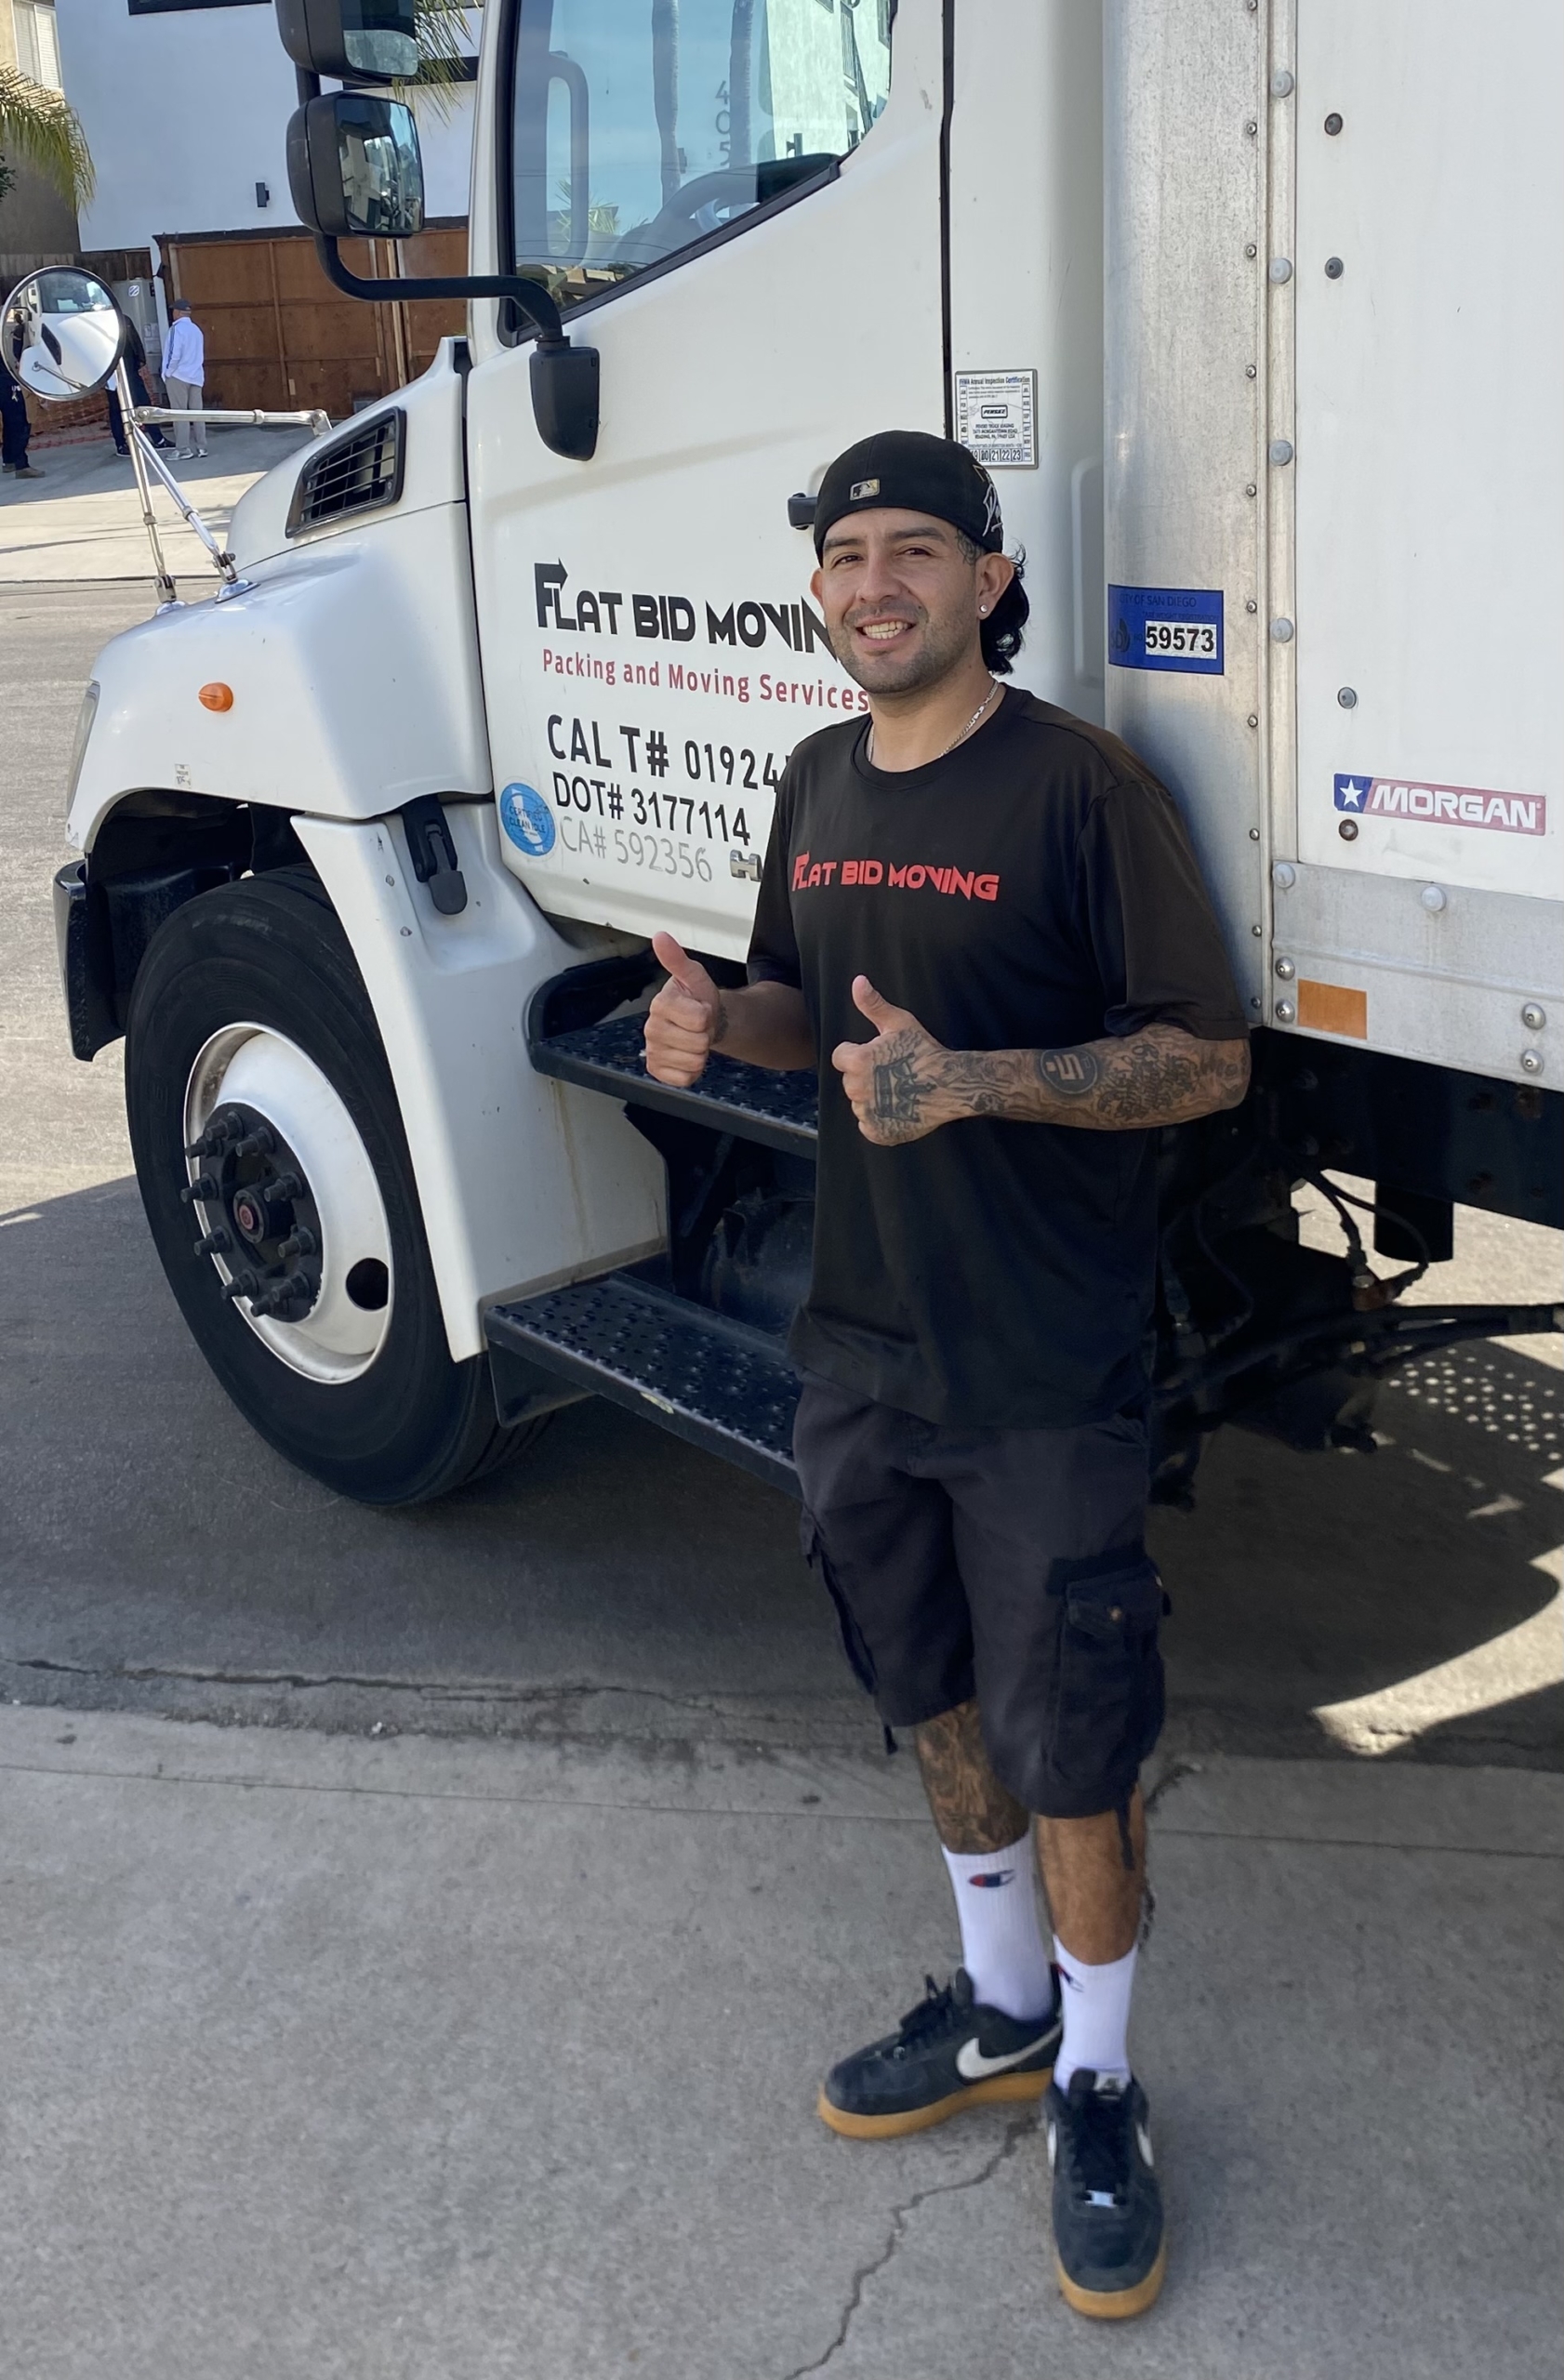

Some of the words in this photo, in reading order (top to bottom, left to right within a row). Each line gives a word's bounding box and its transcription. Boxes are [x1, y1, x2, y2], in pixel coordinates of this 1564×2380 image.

[992, 450, 999, 461] 21
[1002, 450, 1011, 461] 22
[1013, 450, 1021, 461] 23
[534, 558, 623, 635] FLAT
[633, 593, 696, 642] BID
[706, 596, 837, 663] MOVIN
[1135, 595, 1145, 606] OF
[1147, 595, 1165, 606] SAN
[1167, 597, 1197, 608] DIEGO
[1146, 626, 1214, 652] 59573
[543, 649, 616, 685] Packing
[624, 661, 660, 687] and
[669, 664, 750, 703] Moving
[760, 674, 869, 712] Services
[548, 714, 612, 770] CAL
[620, 725, 669, 779] T#
[685, 740, 790, 794] 01924
[509, 805, 543, 822] CERTIFIED
[509, 817, 531, 829] CLEAN
[552, 772, 624, 821] DOT#
[631, 788, 751, 846] 3177114
[1372, 785, 1537, 829] MORGAN
[559, 816, 607, 859] CA#
[615, 829, 713, 883] 592356
[792, 850, 837, 892] FLAT
[841, 859, 883, 885] BID
[888, 862, 1000, 901] MOVING
